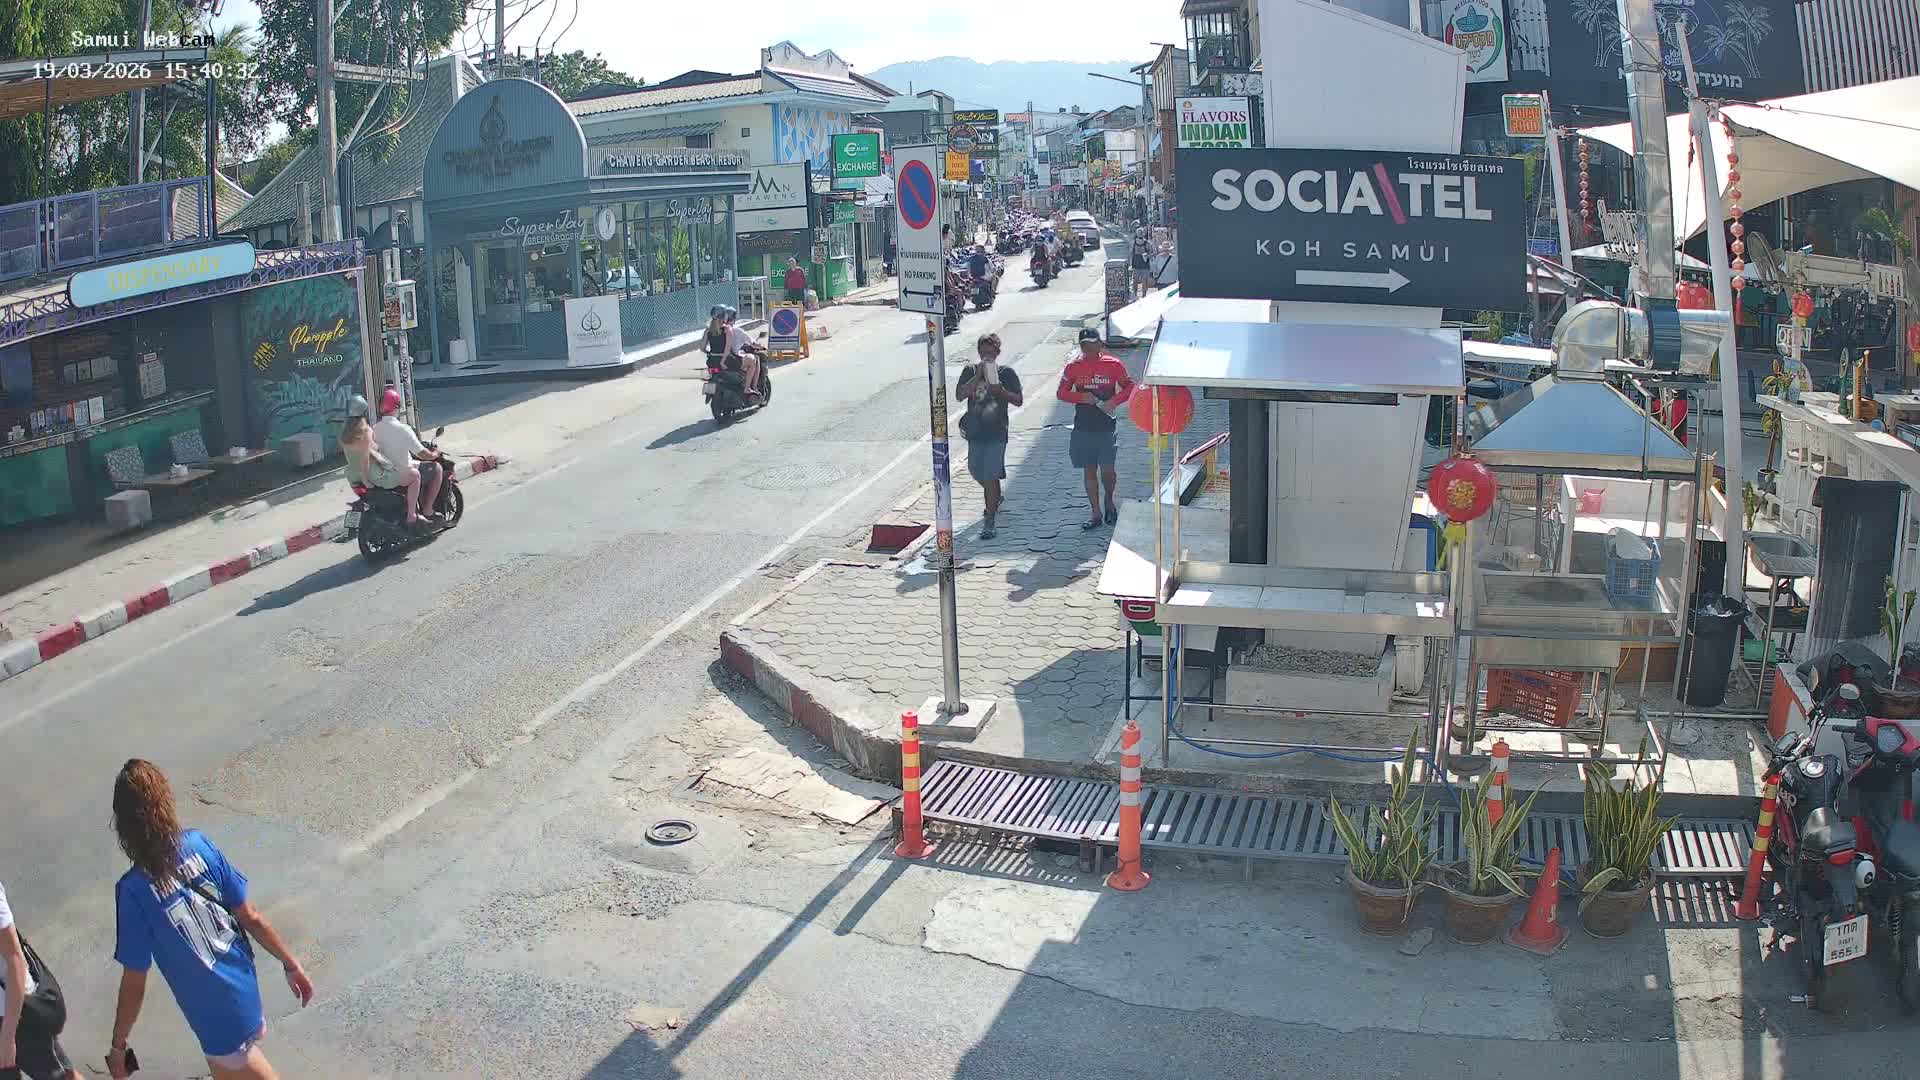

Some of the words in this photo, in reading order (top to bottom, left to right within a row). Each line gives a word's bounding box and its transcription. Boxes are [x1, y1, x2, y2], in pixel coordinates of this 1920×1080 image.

[1182, 111, 1247, 123] FLAVORS
[1180, 123, 1247, 141] INDIAN
[608, 154, 653, 167] CHAWENG
[655, 154, 689, 166] GARDEN
[690, 154, 716, 166] BEACH
[718, 154, 744, 166] RESORT
[836, 161, 878, 172] EXCHANGE
[1255, 239, 1321, 257] KOH
[1343, 242, 1449, 262] SAMUI
[109, 256, 222, 293] DISPENSARY
[904, 270, 912, 279] NO
[913, 271, 937, 281] PARKING
[297, 354, 344, 367] THAILAND
